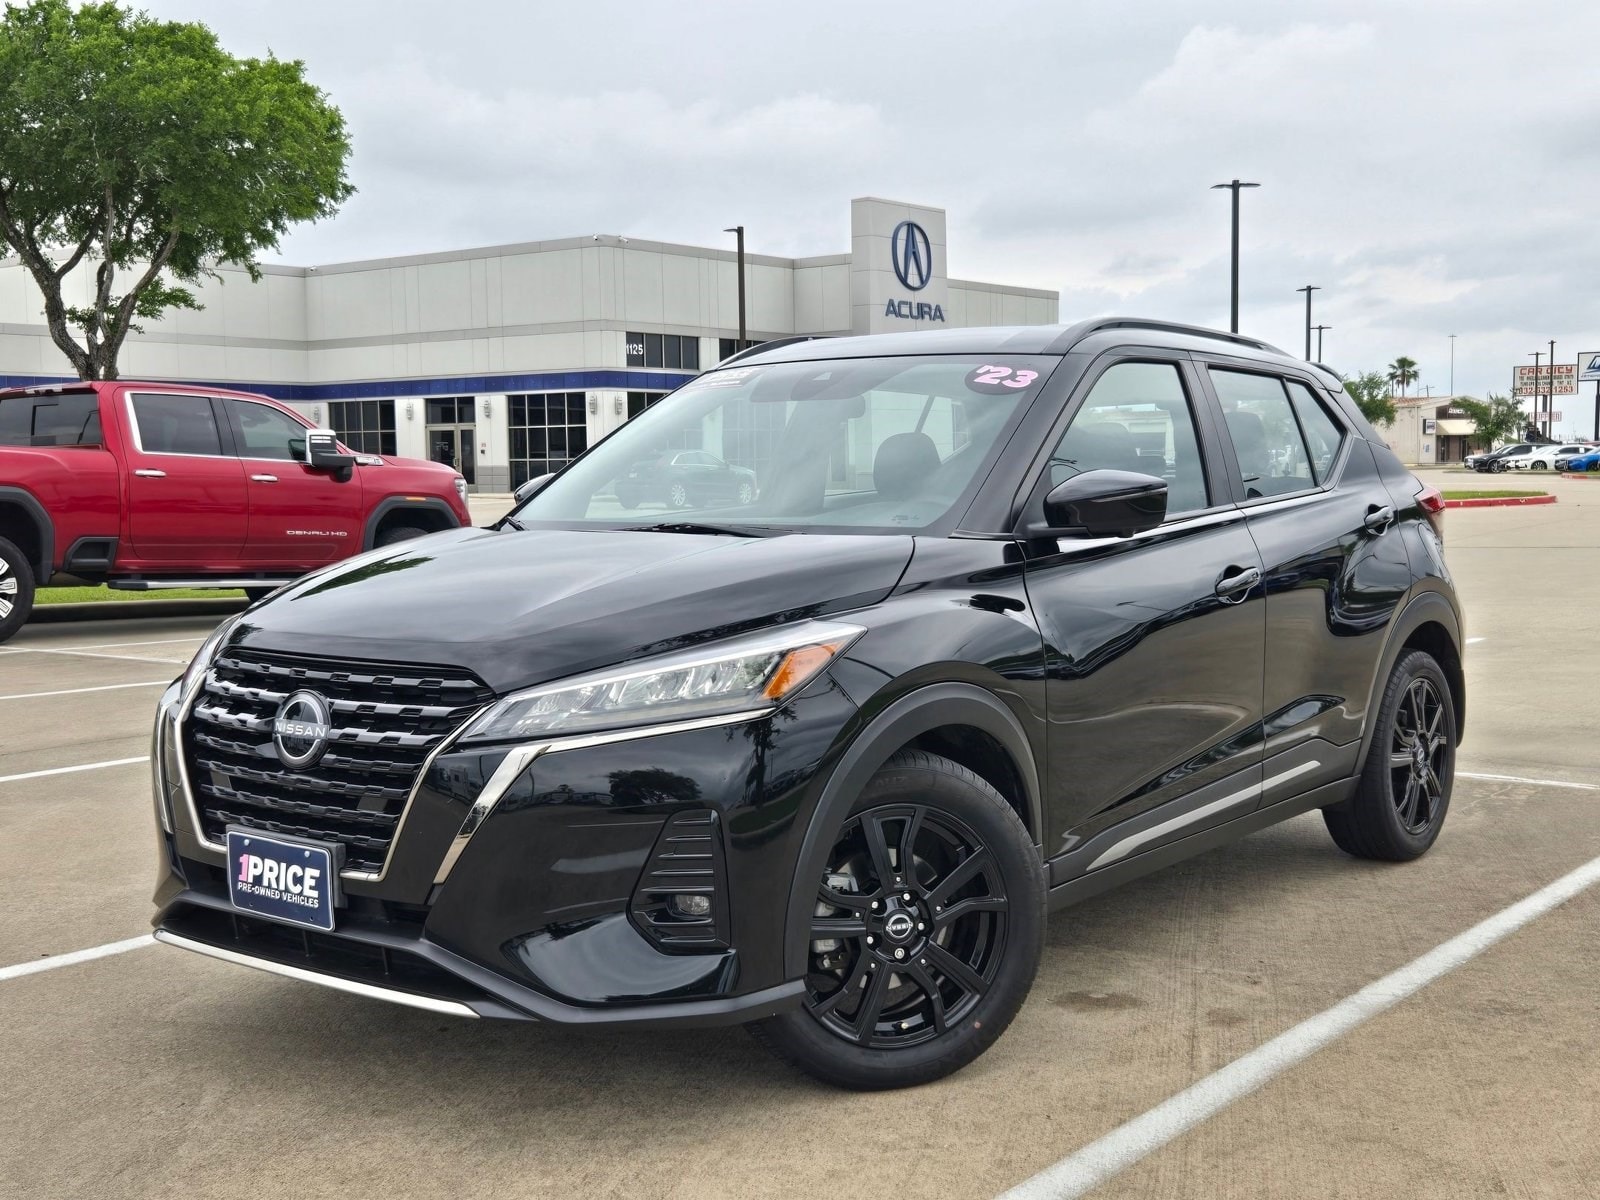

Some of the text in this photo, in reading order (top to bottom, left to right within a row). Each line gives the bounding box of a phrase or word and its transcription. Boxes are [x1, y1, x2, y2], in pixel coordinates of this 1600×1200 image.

[885, 299, 945, 322] ACURA
[626, 343, 644, 355] 1125
[275, 722, 326, 737] NISSAN
[237, 882, 319, 908] PRE-OWNED VEHICLES
